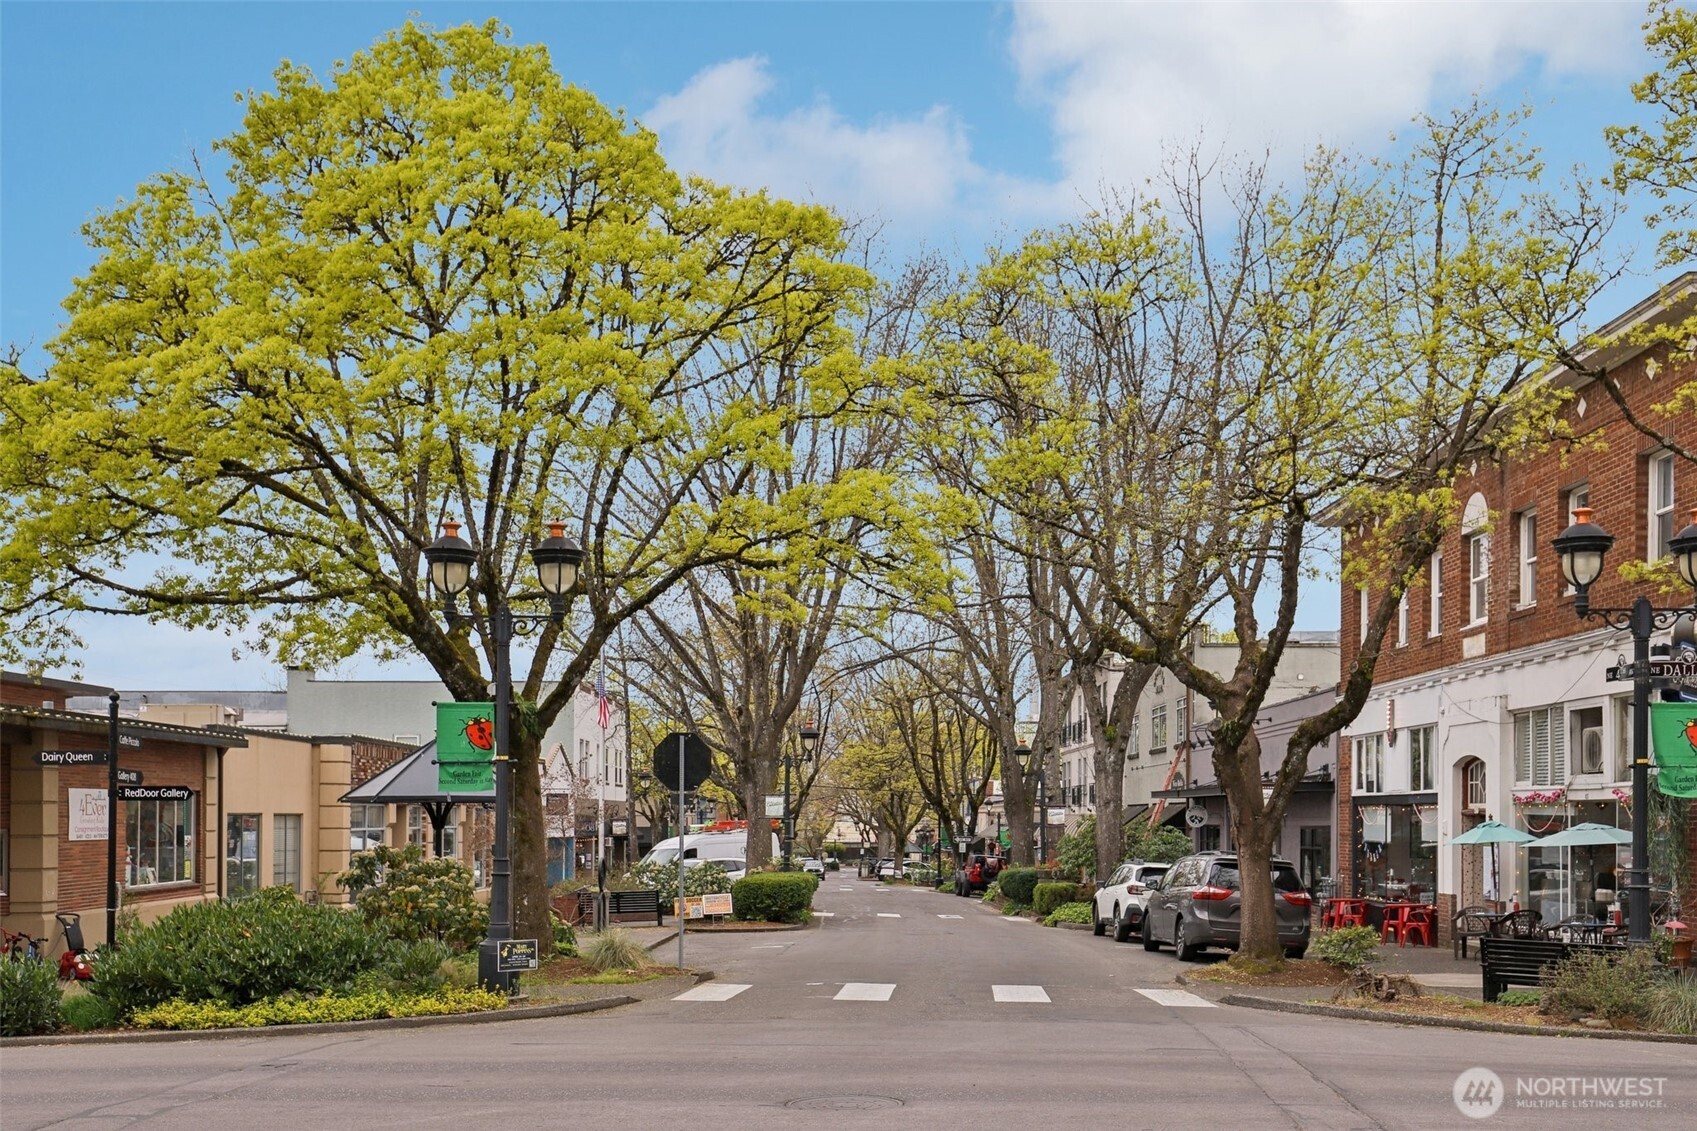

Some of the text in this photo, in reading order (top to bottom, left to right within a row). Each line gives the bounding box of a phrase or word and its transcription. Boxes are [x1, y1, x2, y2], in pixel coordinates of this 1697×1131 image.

[41, 752, 94, 764] Dairy Queen
[124, 788, 189, 800] RedDoor Gallery
